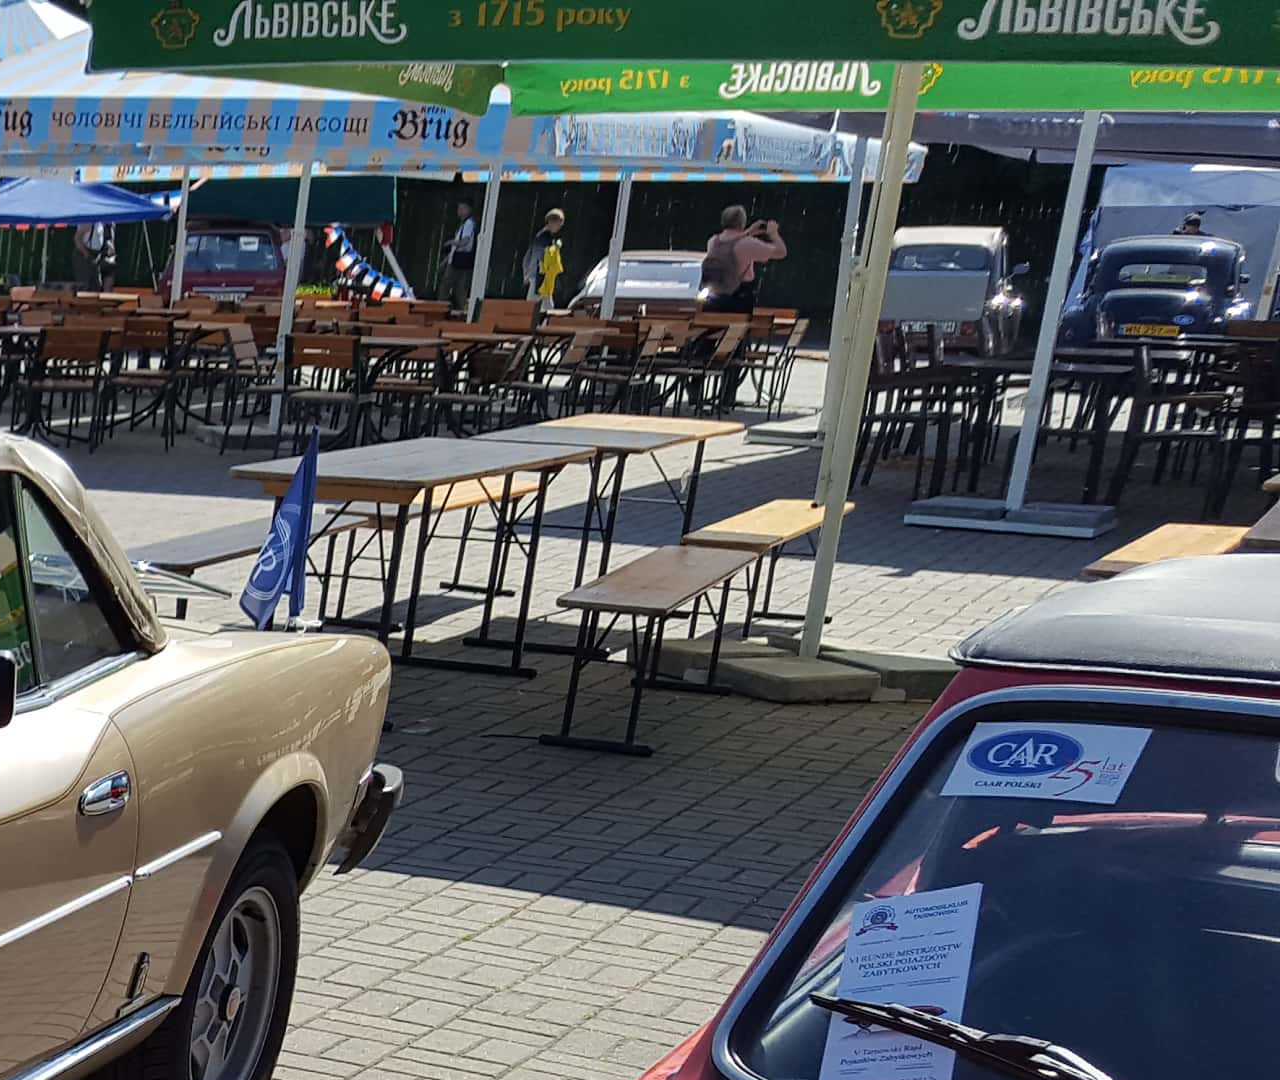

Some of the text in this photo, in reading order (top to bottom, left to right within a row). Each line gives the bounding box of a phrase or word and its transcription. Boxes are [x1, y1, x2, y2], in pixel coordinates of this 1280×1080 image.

[213, 0, 408, 47] ЛЬВІВСЬКЕ
[477, 0, 544, 26] 1715
[557, 3, 632, 32] року
[51, 111, 370, 135] ЧОЛОВІЧІ БЕЛЬГІЙСЬКІ ЛАСОЩІ
[388, 110, 470, 148] Brug
[987, 737, 1059, 768] CAR
[974, 780, 1042, 790] CAAR POLSKI
[896, 942, 962, 957] MISTRZOSTW
[859, 961, 893, 970] POLSKI
